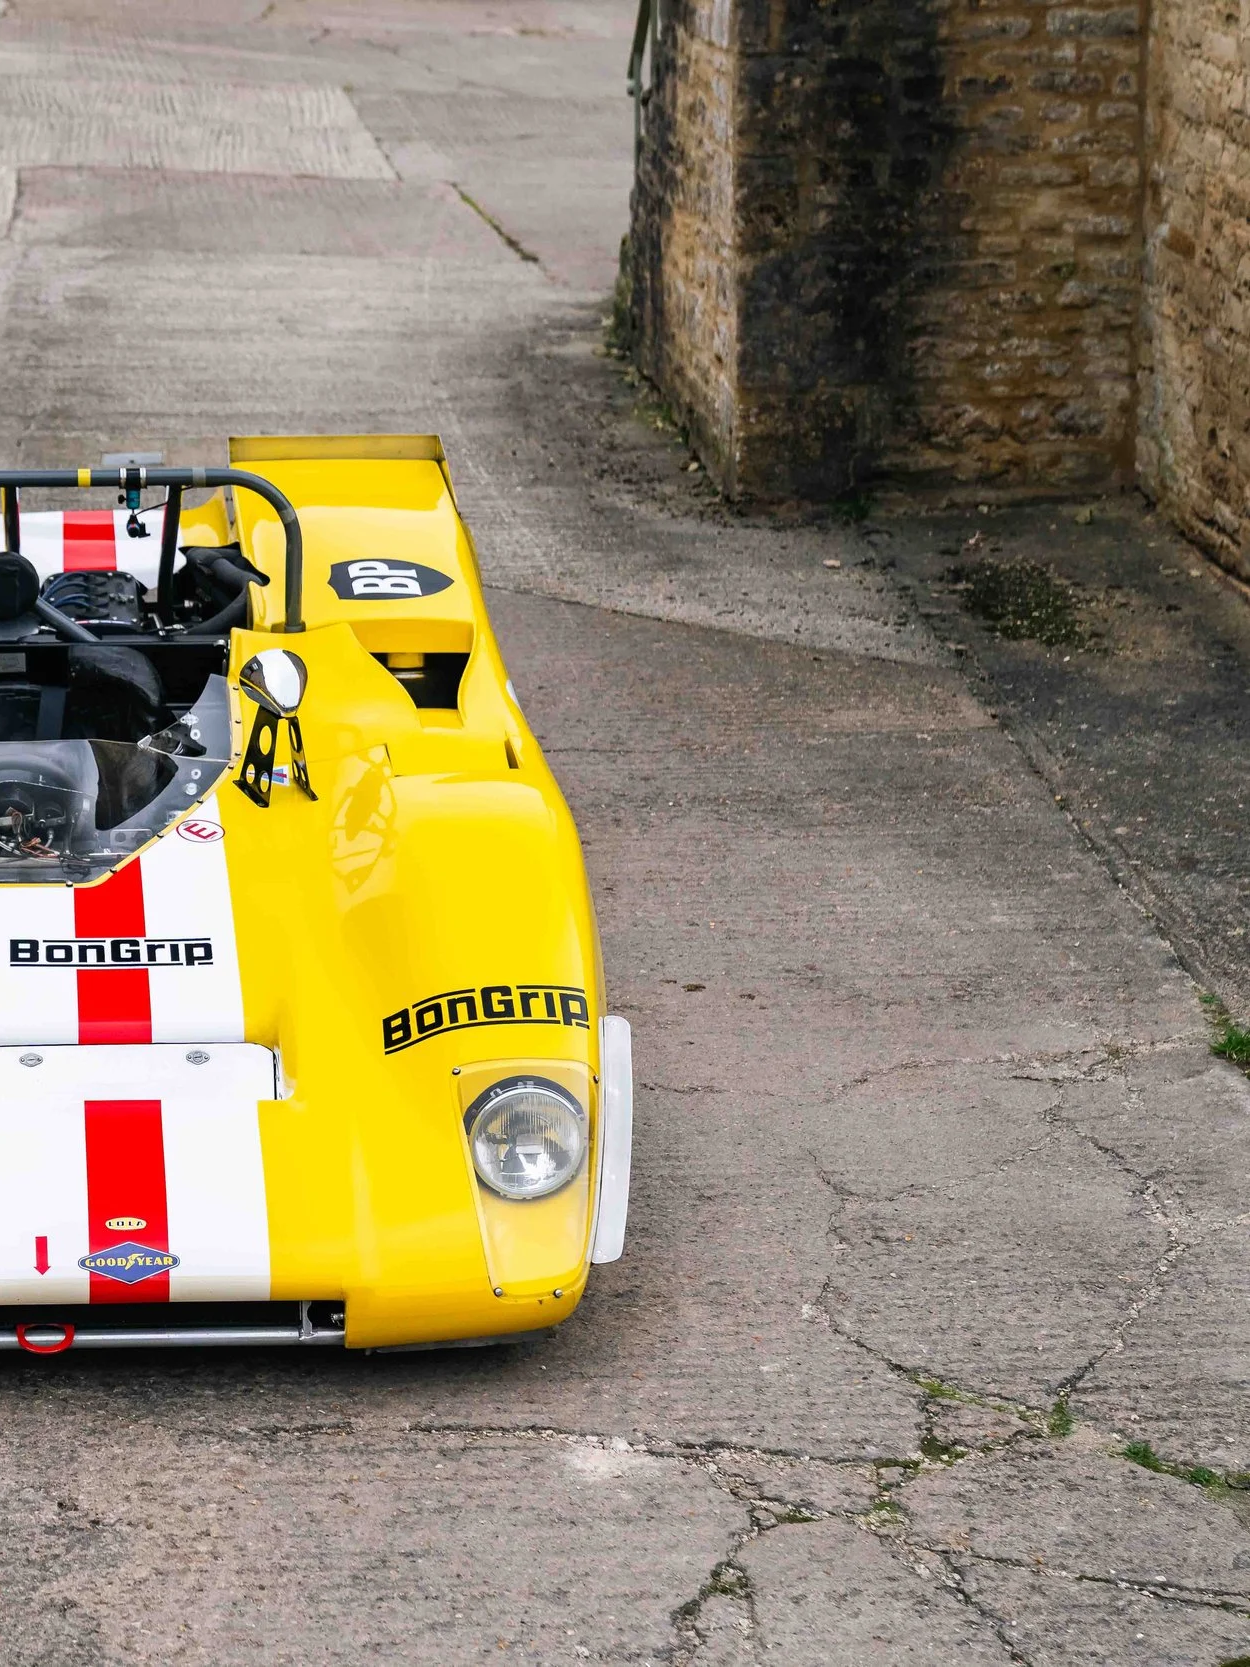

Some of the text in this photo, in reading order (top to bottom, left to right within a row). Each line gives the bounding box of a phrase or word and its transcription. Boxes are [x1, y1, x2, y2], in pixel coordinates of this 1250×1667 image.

[347, 560, 422, 596] BP
[183, 822, 218, 840] E
[9, 938, 214, 968] BonGrip
[382, 985, 591, 1056] BonGrip
